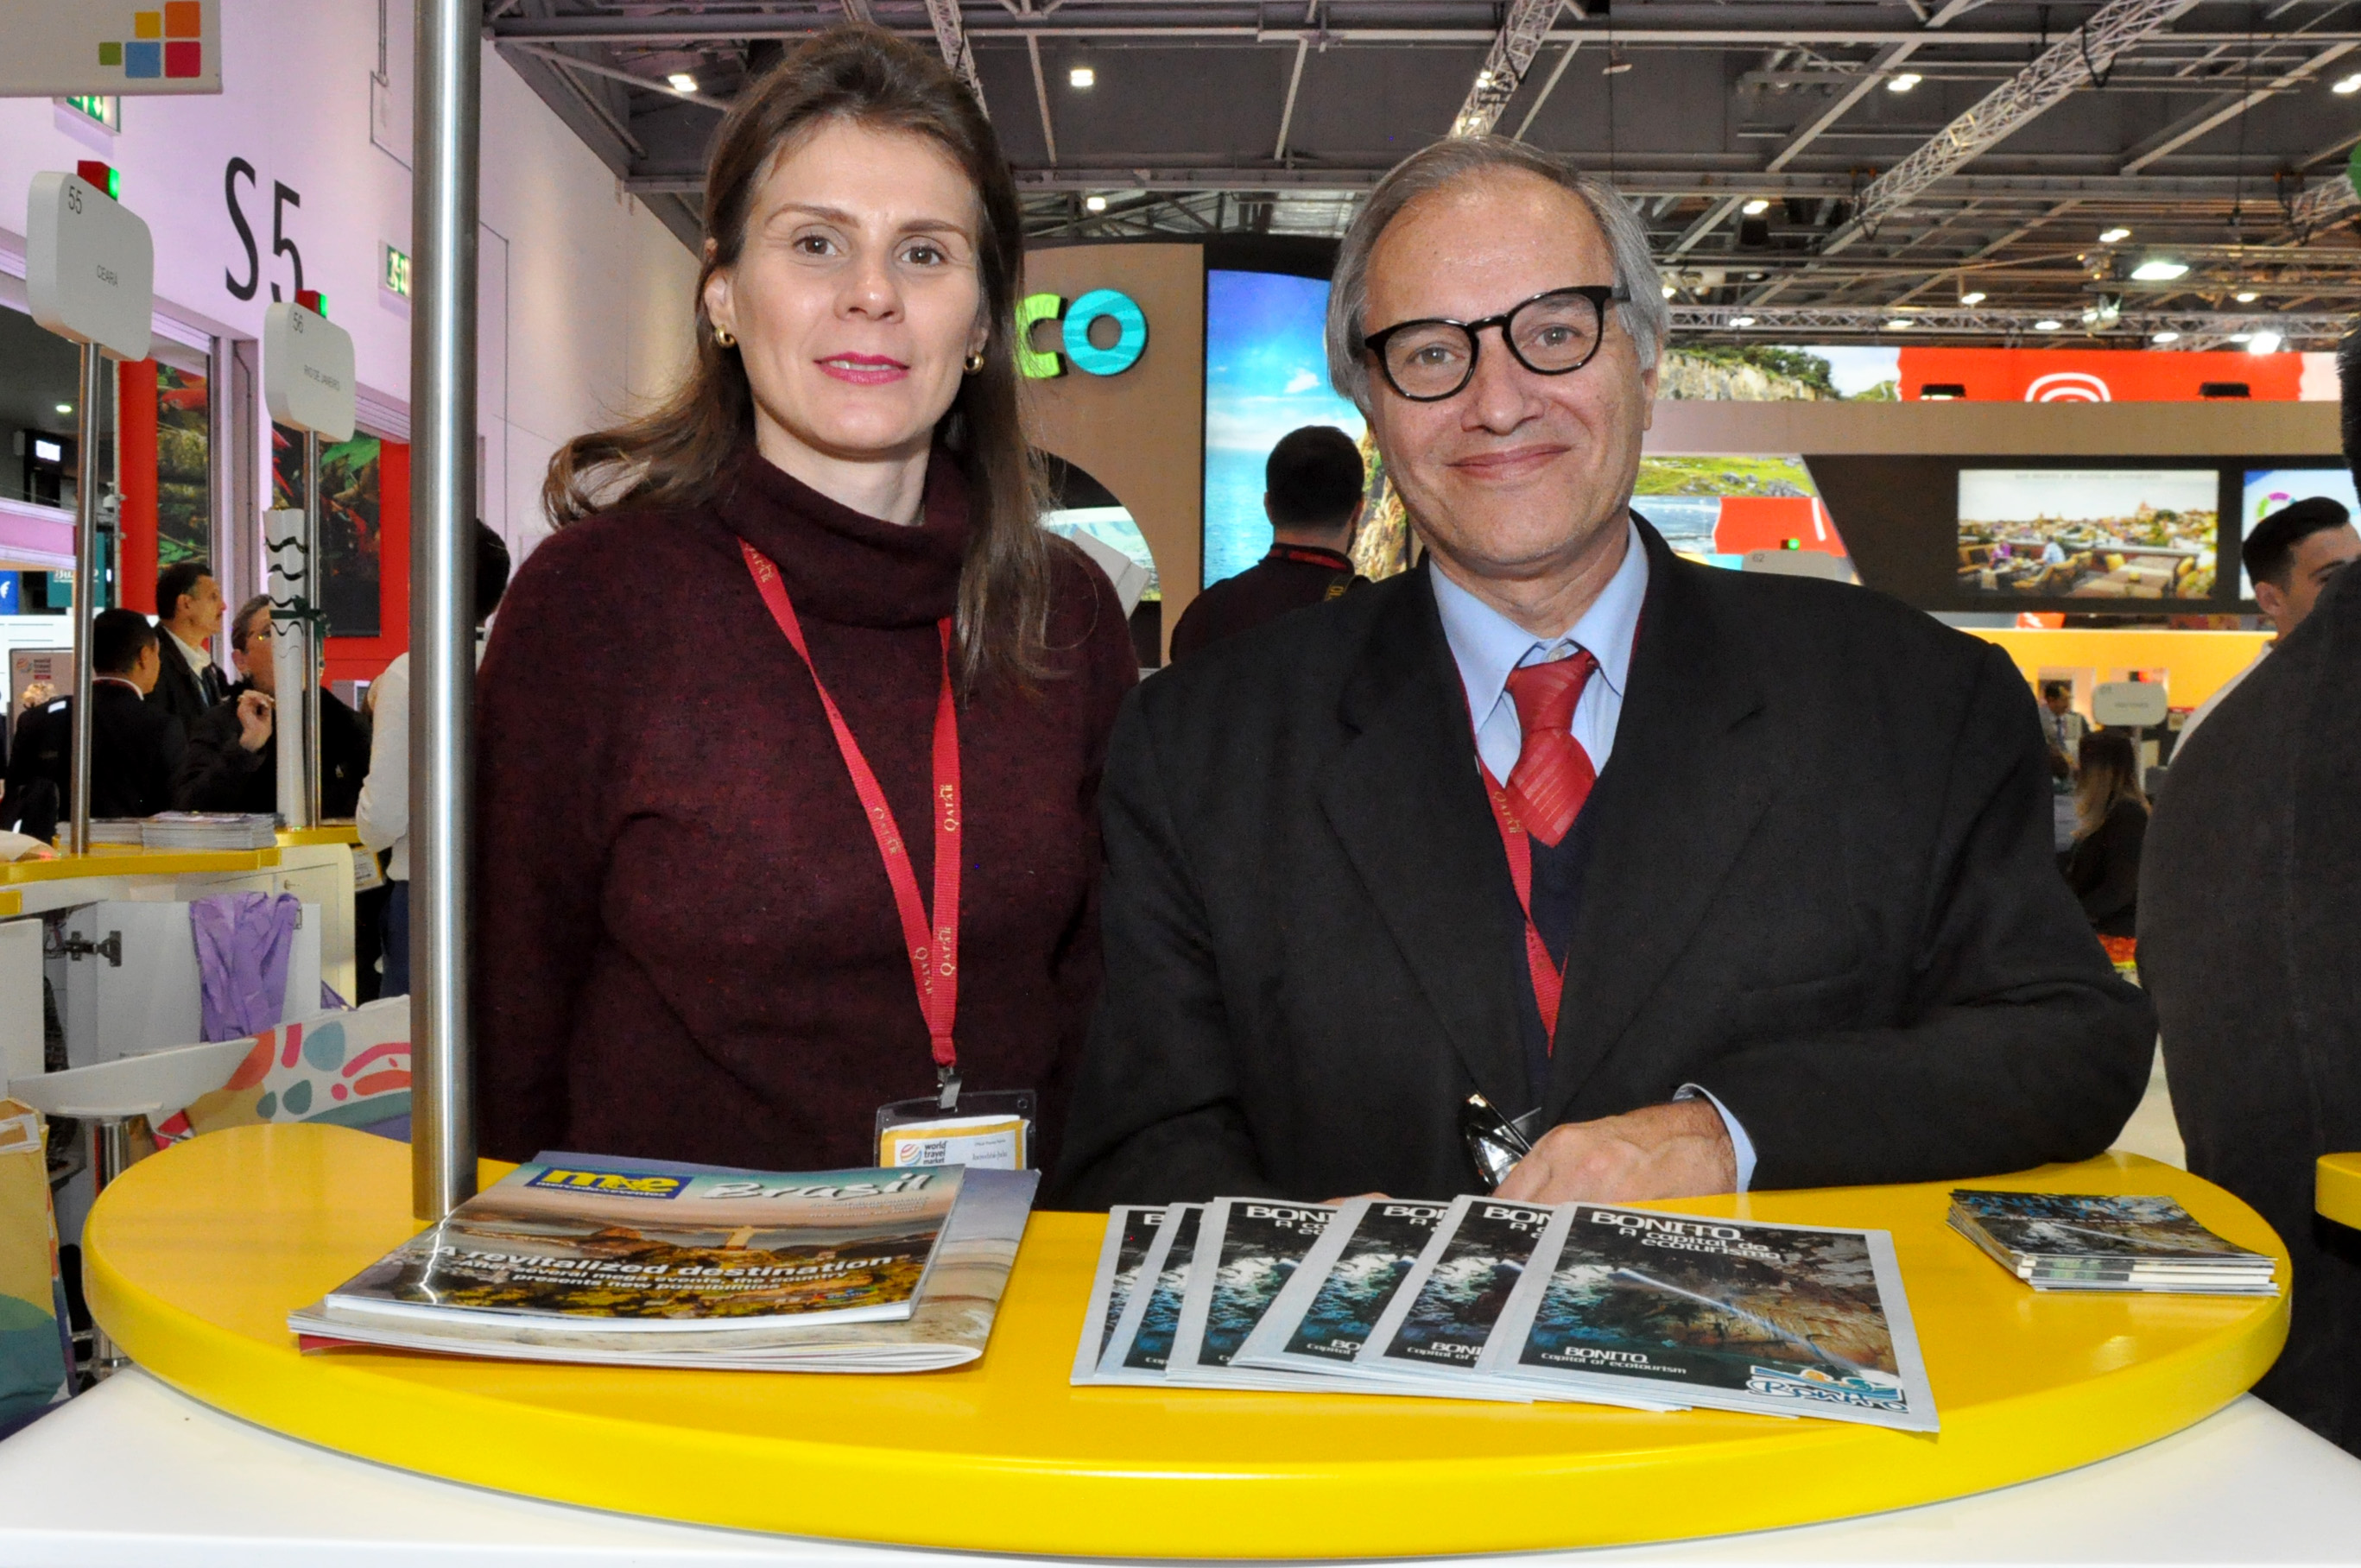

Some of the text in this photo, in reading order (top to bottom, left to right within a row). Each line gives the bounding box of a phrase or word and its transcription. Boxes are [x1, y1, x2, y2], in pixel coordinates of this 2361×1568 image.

[68, 186, 82, 214] 55
[225, 156, 303, 303] S5
[294, 312, 303, 333] 56
[924, 1141, 947, 1150] world
[700, 1173, 935, 1200] Brasil
[1618, 1227, 1637, 1236] A
[1646, 1232, 1729, 1247] capital
[1642, 1238, 1781, 1260] ecoturismo
[437, 1246, 893, 1277] A revitalized destination
[459, 1260, 510, 1271] After
[517, 1266, 588, 1279] several
[592, 1274, 649, 1282] mega
[654, 1276, 725, 1285] events,
[770, 1271, 849, 1284] country
[512, 1274, 603, 1287] presents
[654, 1282, 781, 1291] possibilities
[1307, 1343, 1351, 1355] Capital
[1407, 1346, 1453, 1358] Capital
[1541, 1352, 1586, 1364] Capital
[1610, 1361, 1687, 1375] ecotourism
